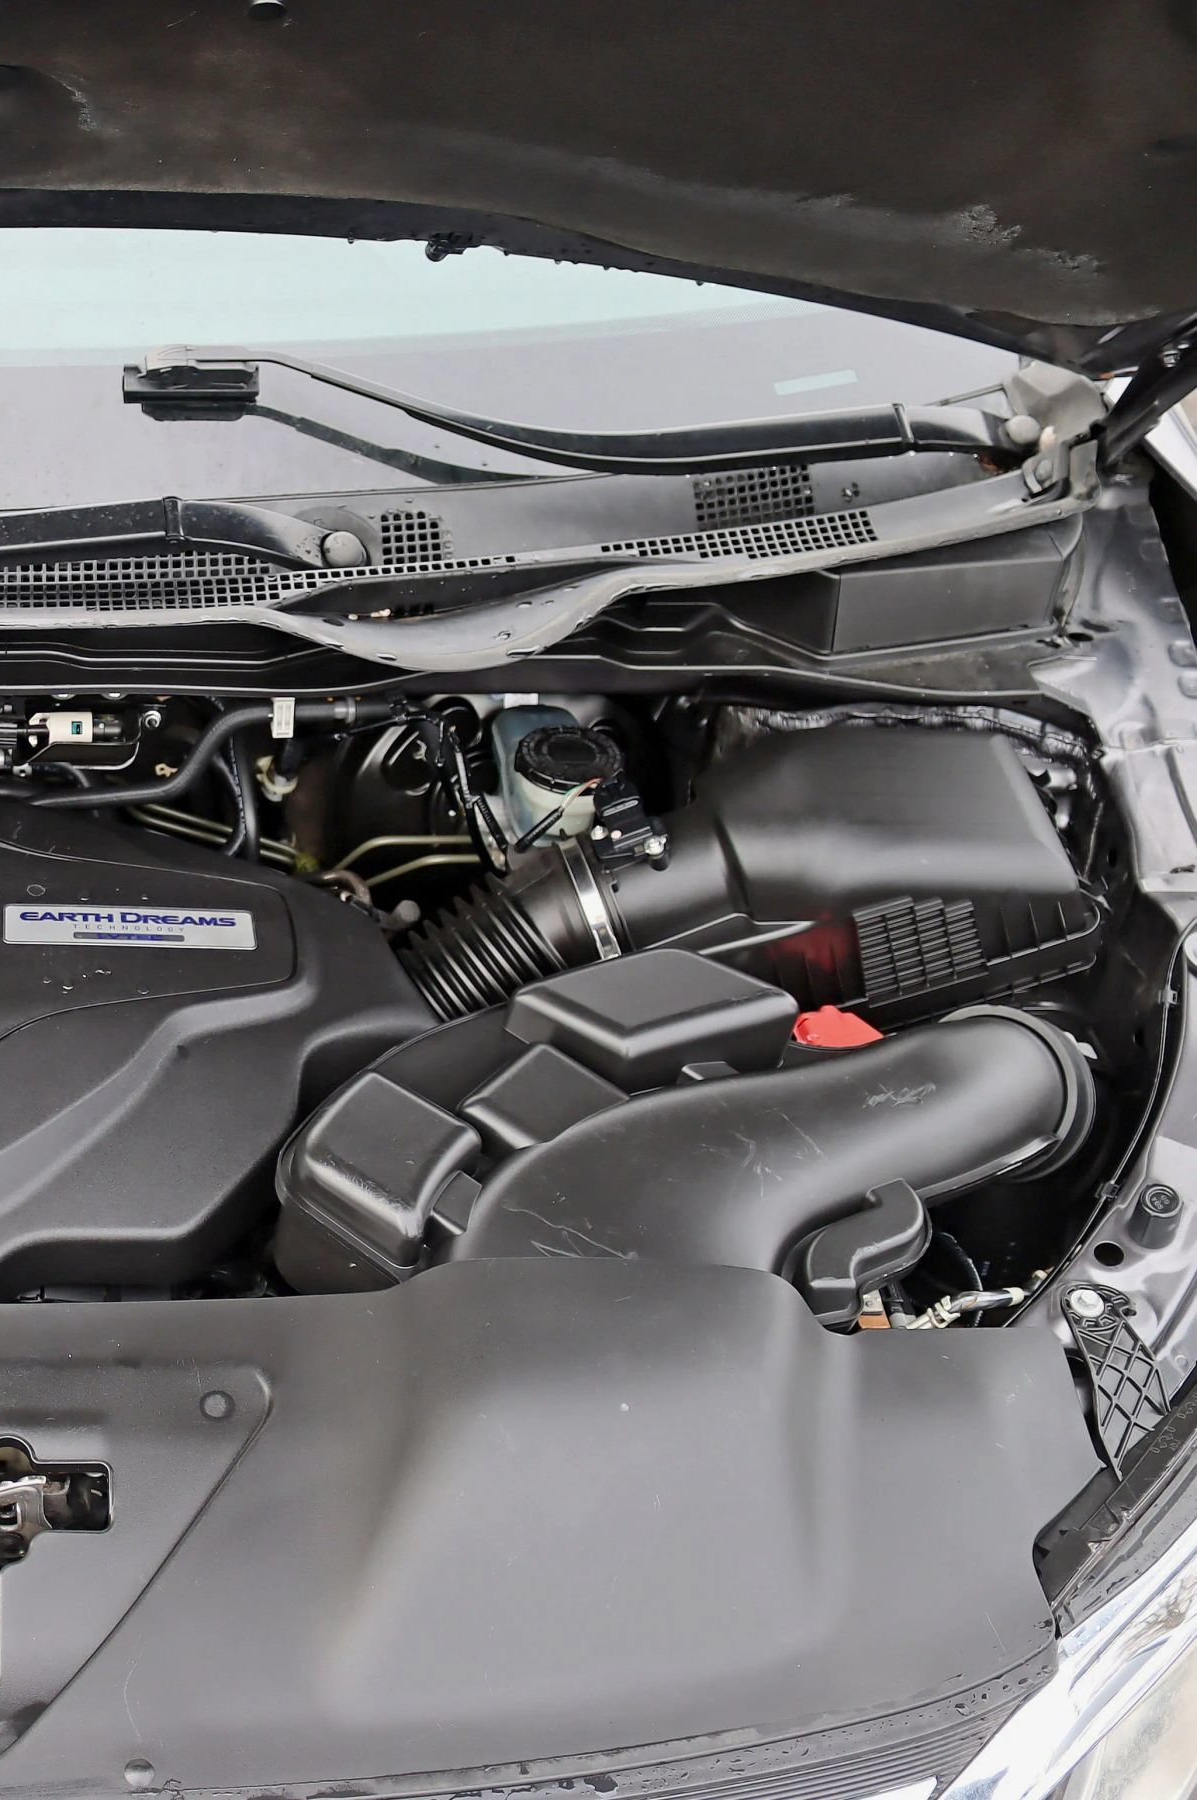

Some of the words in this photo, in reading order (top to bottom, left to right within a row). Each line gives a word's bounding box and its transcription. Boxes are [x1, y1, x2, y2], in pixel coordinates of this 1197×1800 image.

[19, 911, 114, 923] EARTH
[120, 912, 237, 926] DREAMS
[73, 924, 185, 932] TECHNOLOGY
